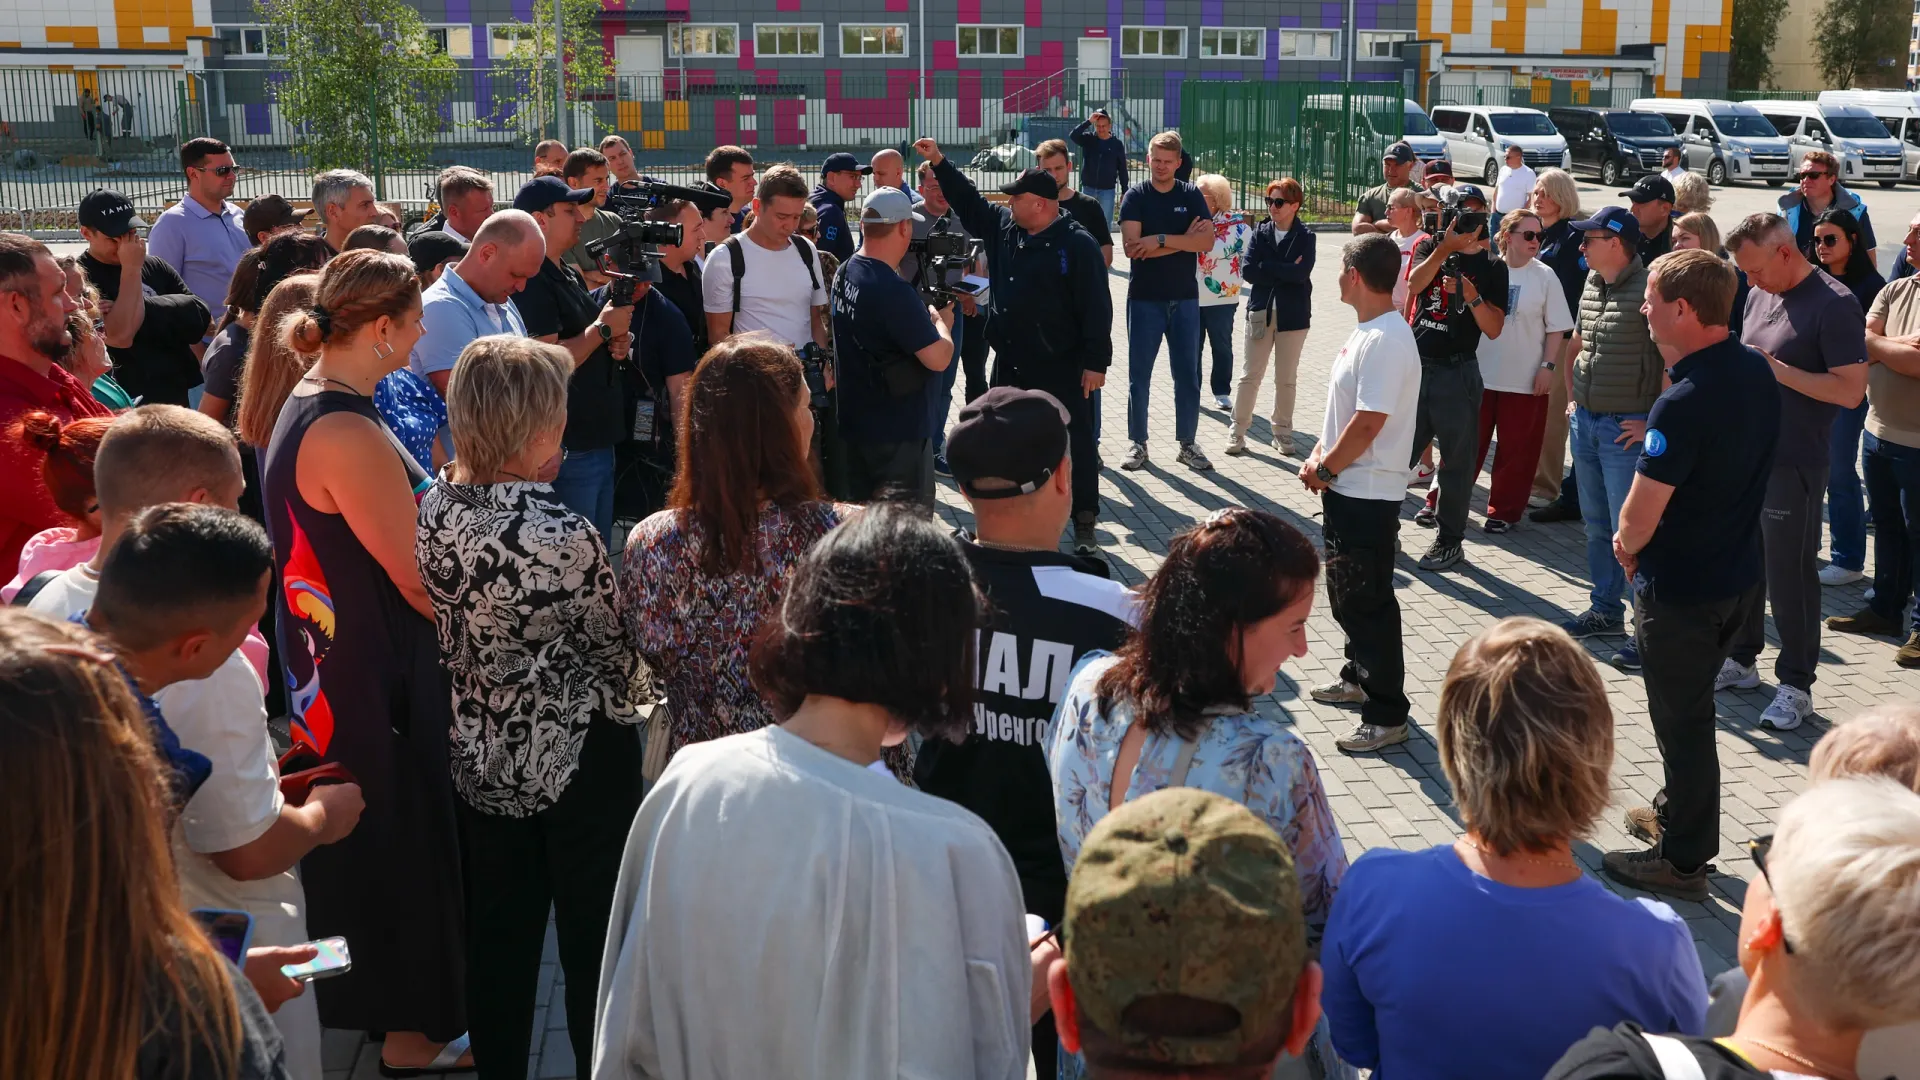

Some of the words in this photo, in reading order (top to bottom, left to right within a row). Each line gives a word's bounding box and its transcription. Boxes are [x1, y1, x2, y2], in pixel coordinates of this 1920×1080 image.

[101, 203, 133, 216] YAMAL
[974, 628, 1074, 704] АЛ
[973, 701, 1049, 746] Уренго
